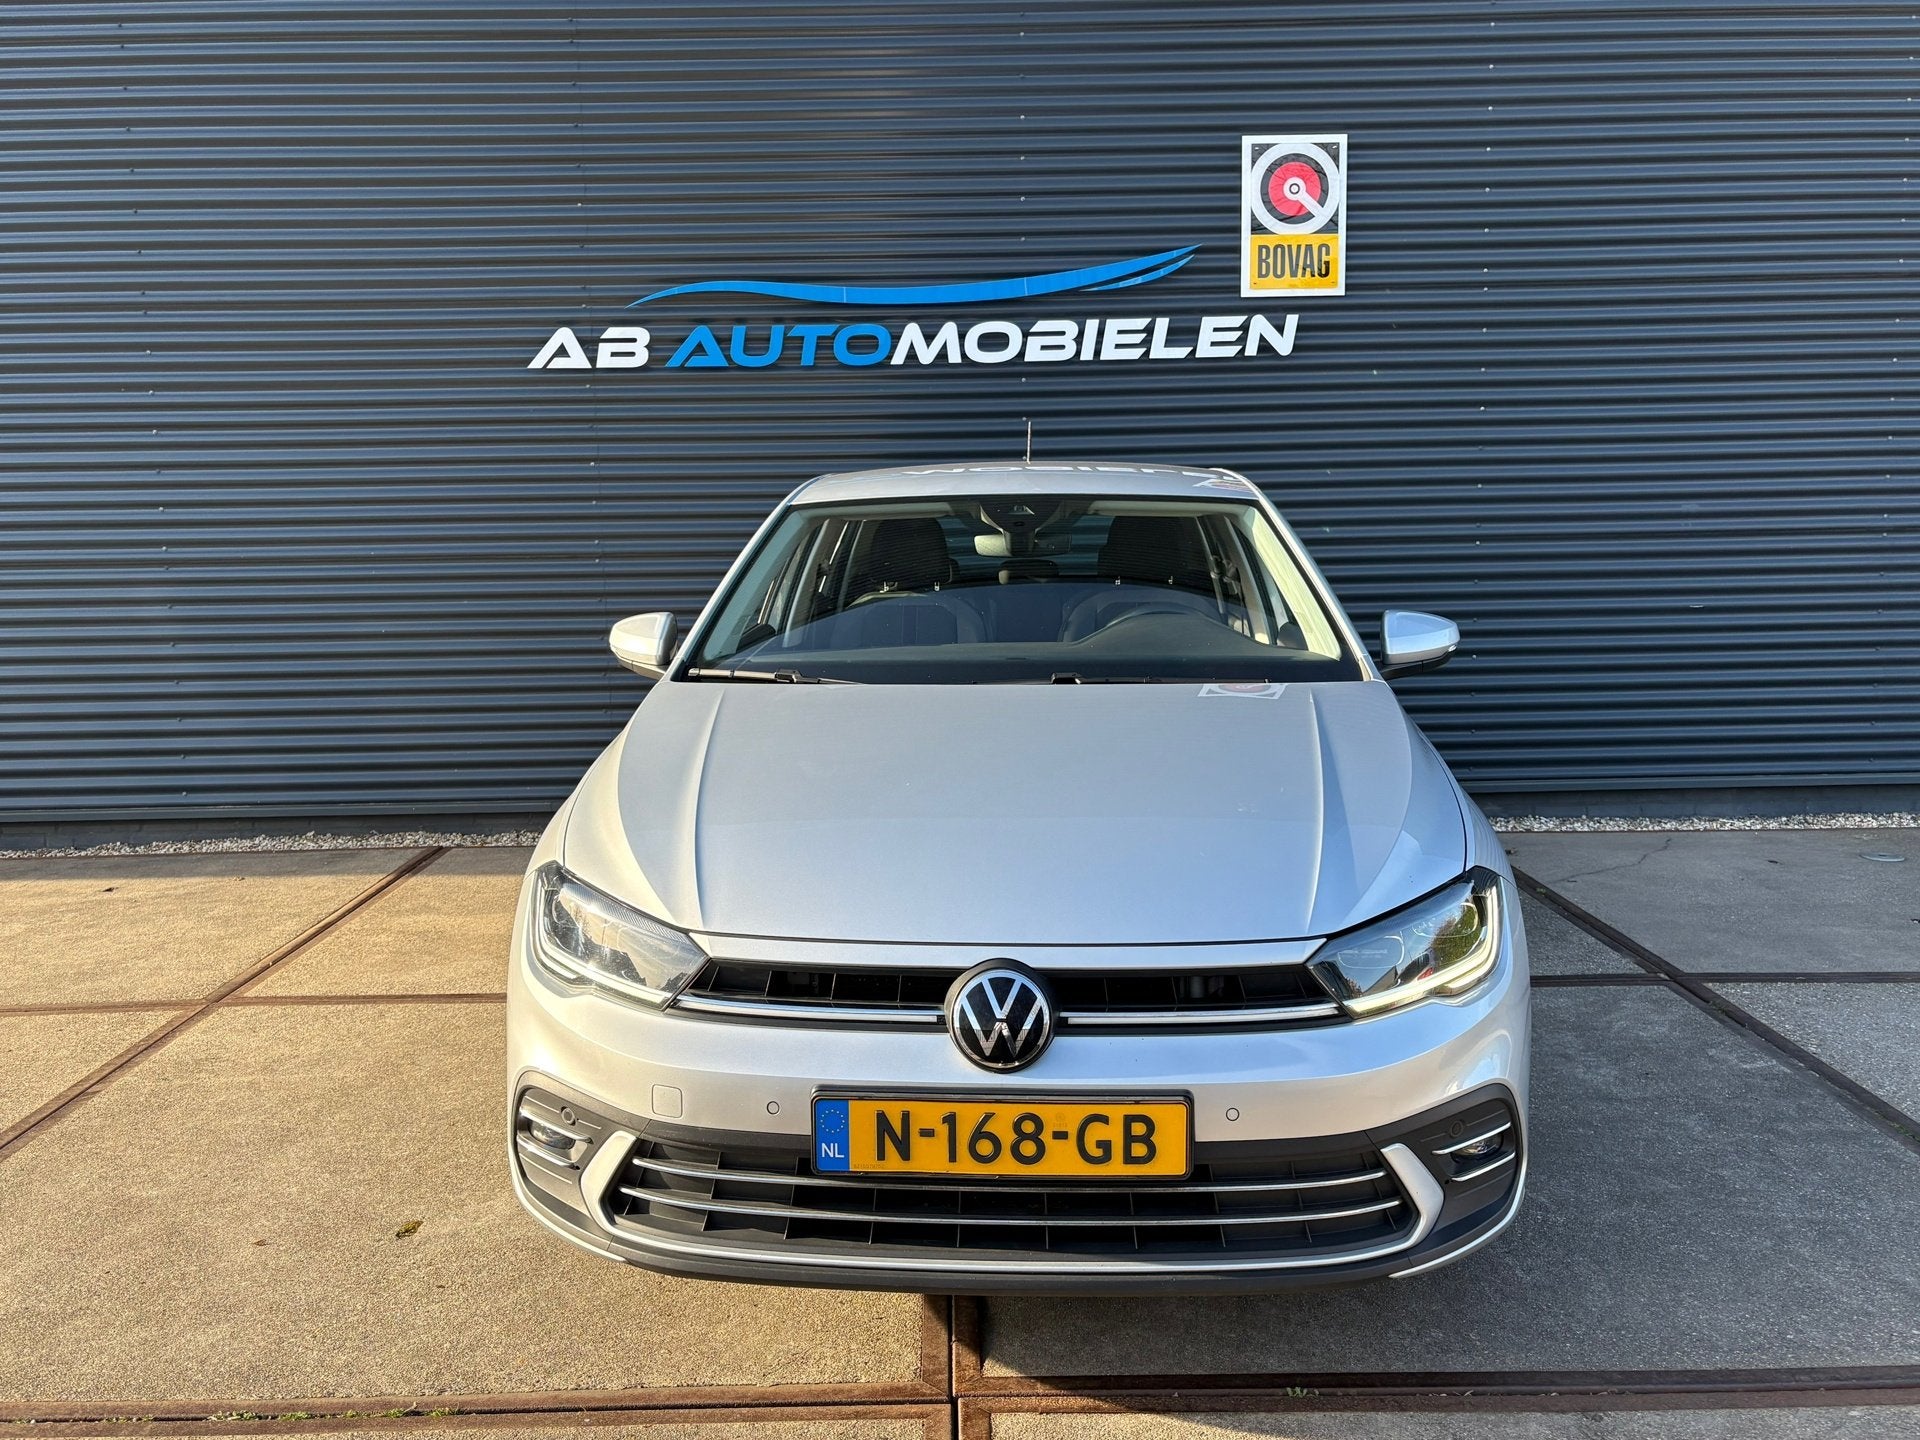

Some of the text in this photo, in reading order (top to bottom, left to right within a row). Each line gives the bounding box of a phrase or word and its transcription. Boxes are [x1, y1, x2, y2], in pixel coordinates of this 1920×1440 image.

[1257, 243, 1331, 279] BOVAG
[527, 314, 1300, 369] AB AUTOMOBIELEN
[821, 1143, 845, 1159] NL
[874, 1109, 1158, 1166] N-168-GB
